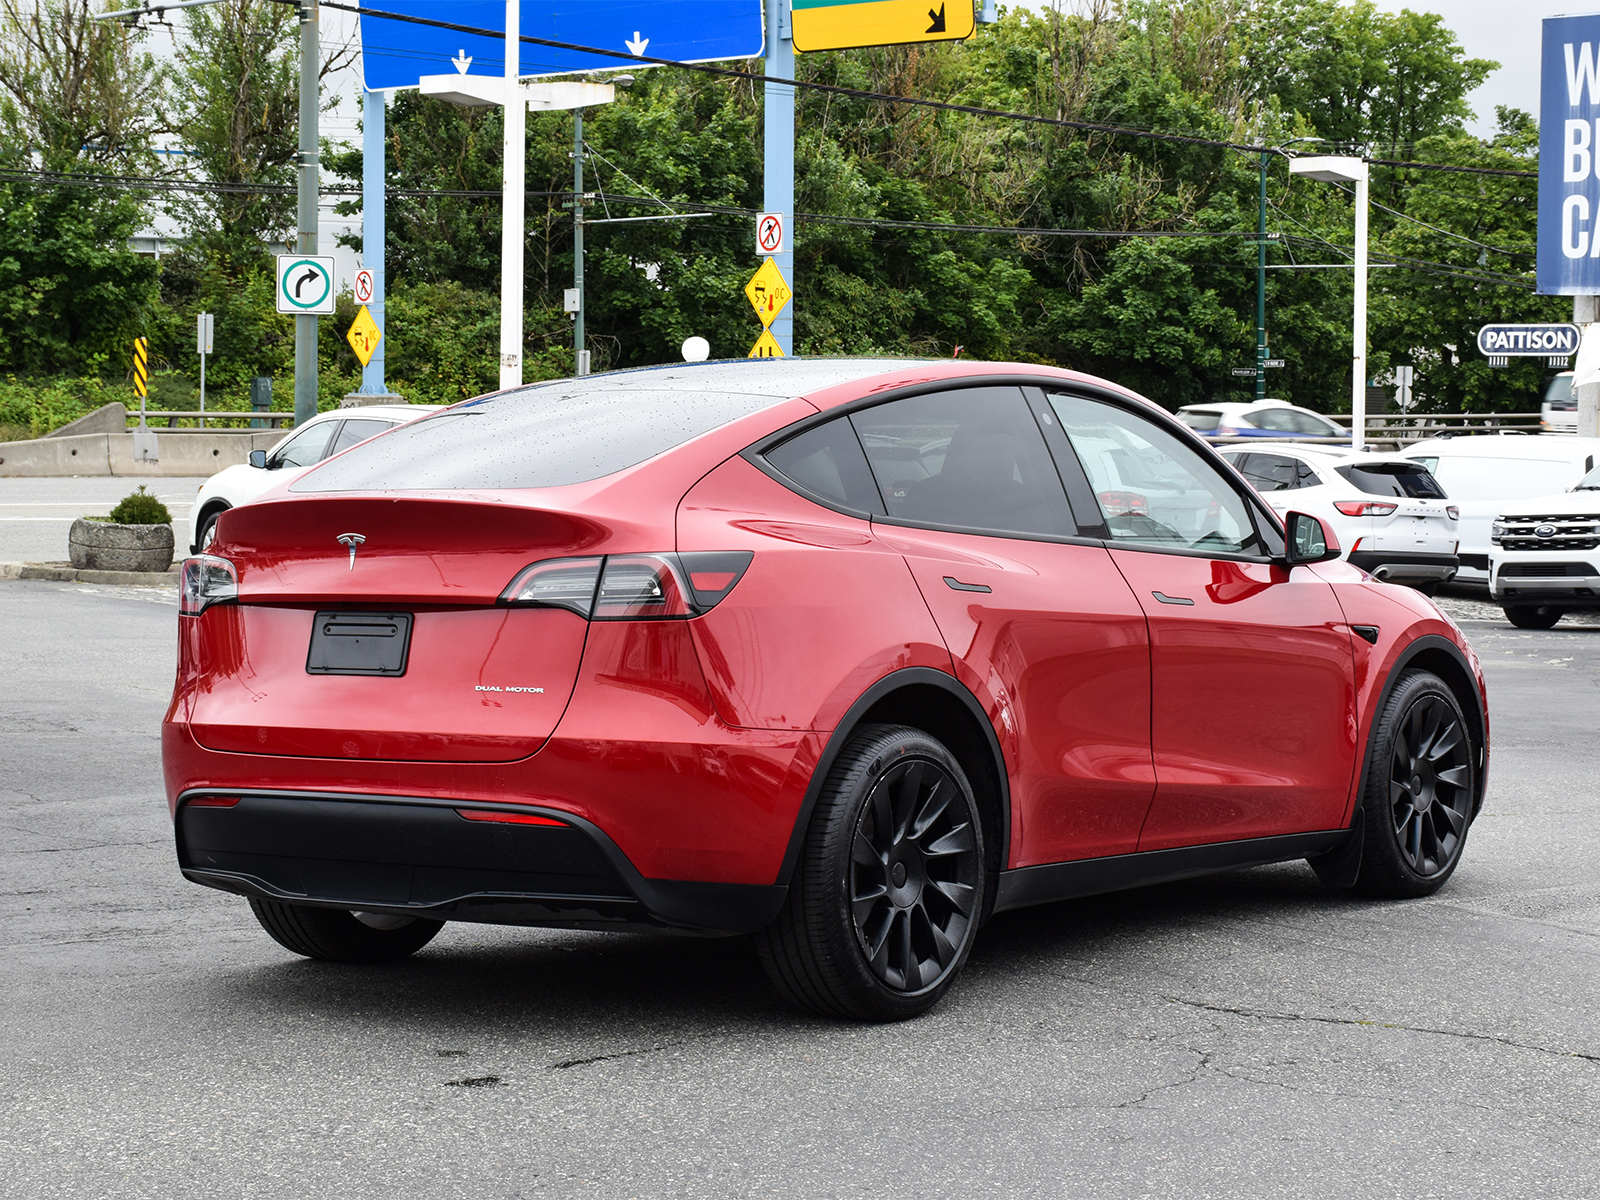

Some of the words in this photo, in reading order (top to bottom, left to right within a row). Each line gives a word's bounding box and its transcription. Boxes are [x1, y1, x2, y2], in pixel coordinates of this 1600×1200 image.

[1563, 117, 1600, 183] B
[1486, 331, 1572, 349] PATTISON
[505, 686, 545, 694] MOTOR
